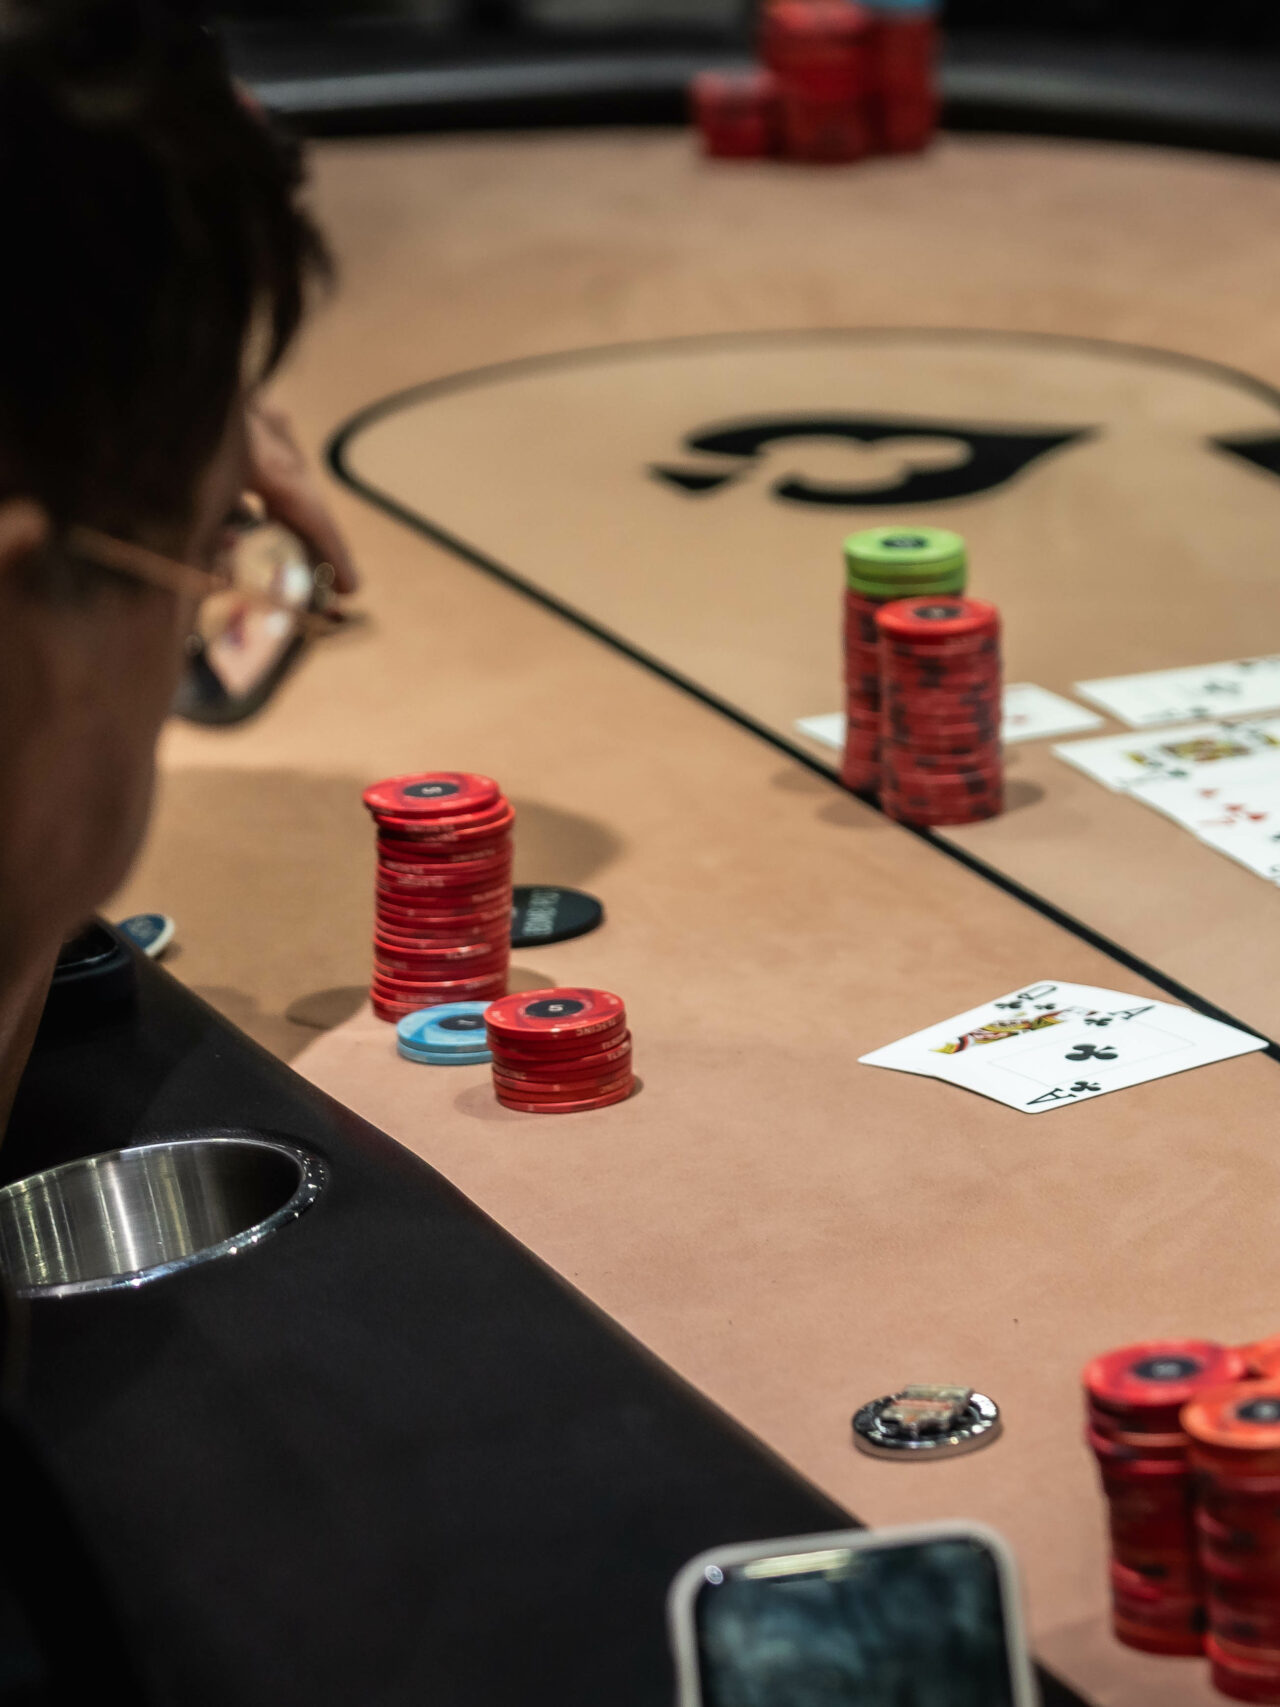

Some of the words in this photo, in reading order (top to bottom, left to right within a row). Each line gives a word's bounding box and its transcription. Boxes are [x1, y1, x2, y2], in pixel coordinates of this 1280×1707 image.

[548, 1003, 564, 1013] 5
[1108, 1004, 1156, 1021] A
[1026, 1087, 1078, 1106] A
